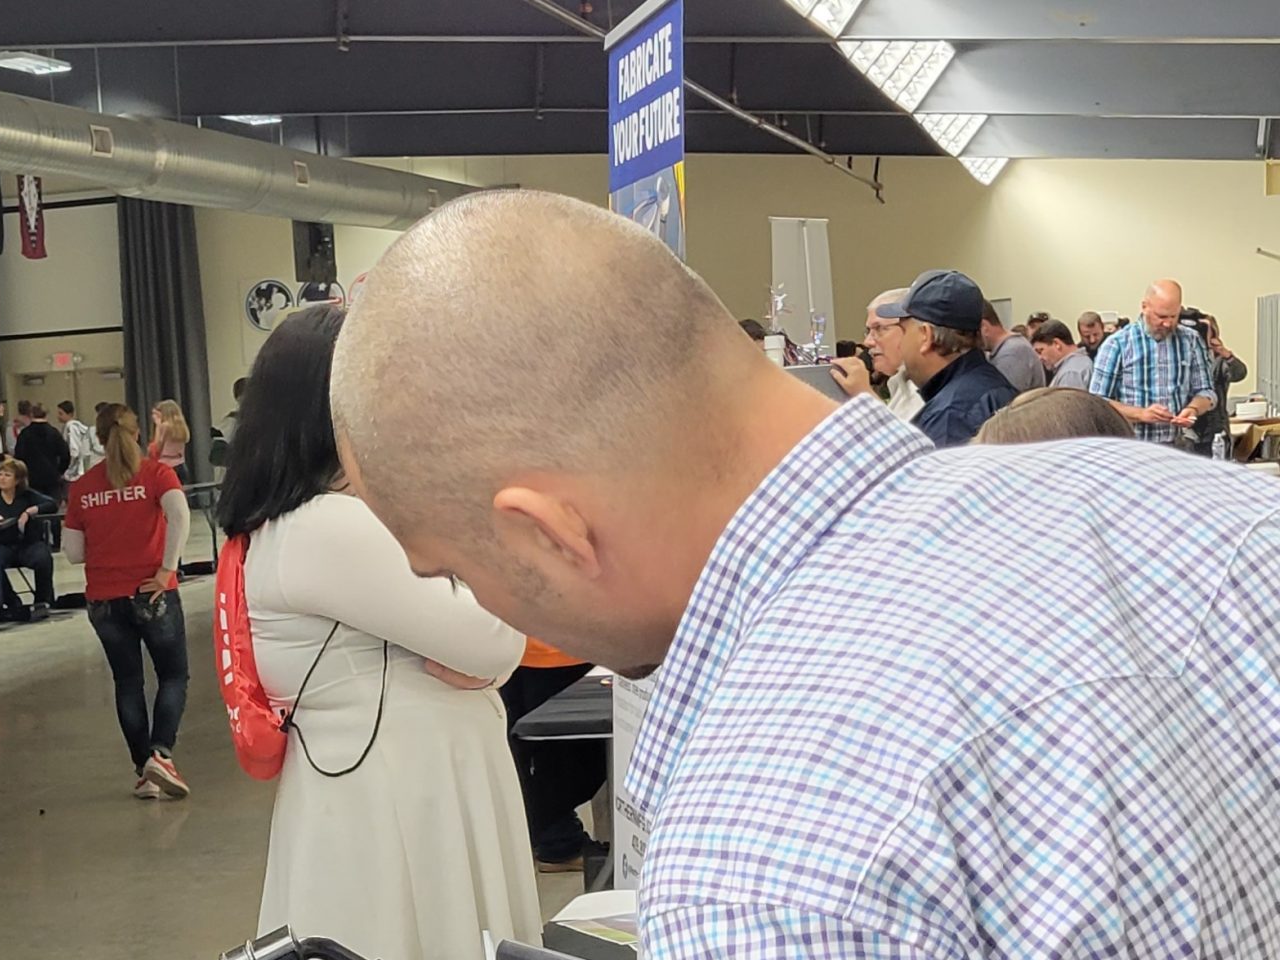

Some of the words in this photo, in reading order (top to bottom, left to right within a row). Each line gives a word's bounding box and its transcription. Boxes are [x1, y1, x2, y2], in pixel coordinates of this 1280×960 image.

[618, 22, 673, 104] FABRICATE
[613, 111, 639, 167] YOUR
[639, 86, 681, 154] FUTURE
[80, 485, 147, 510] SHIFTER
